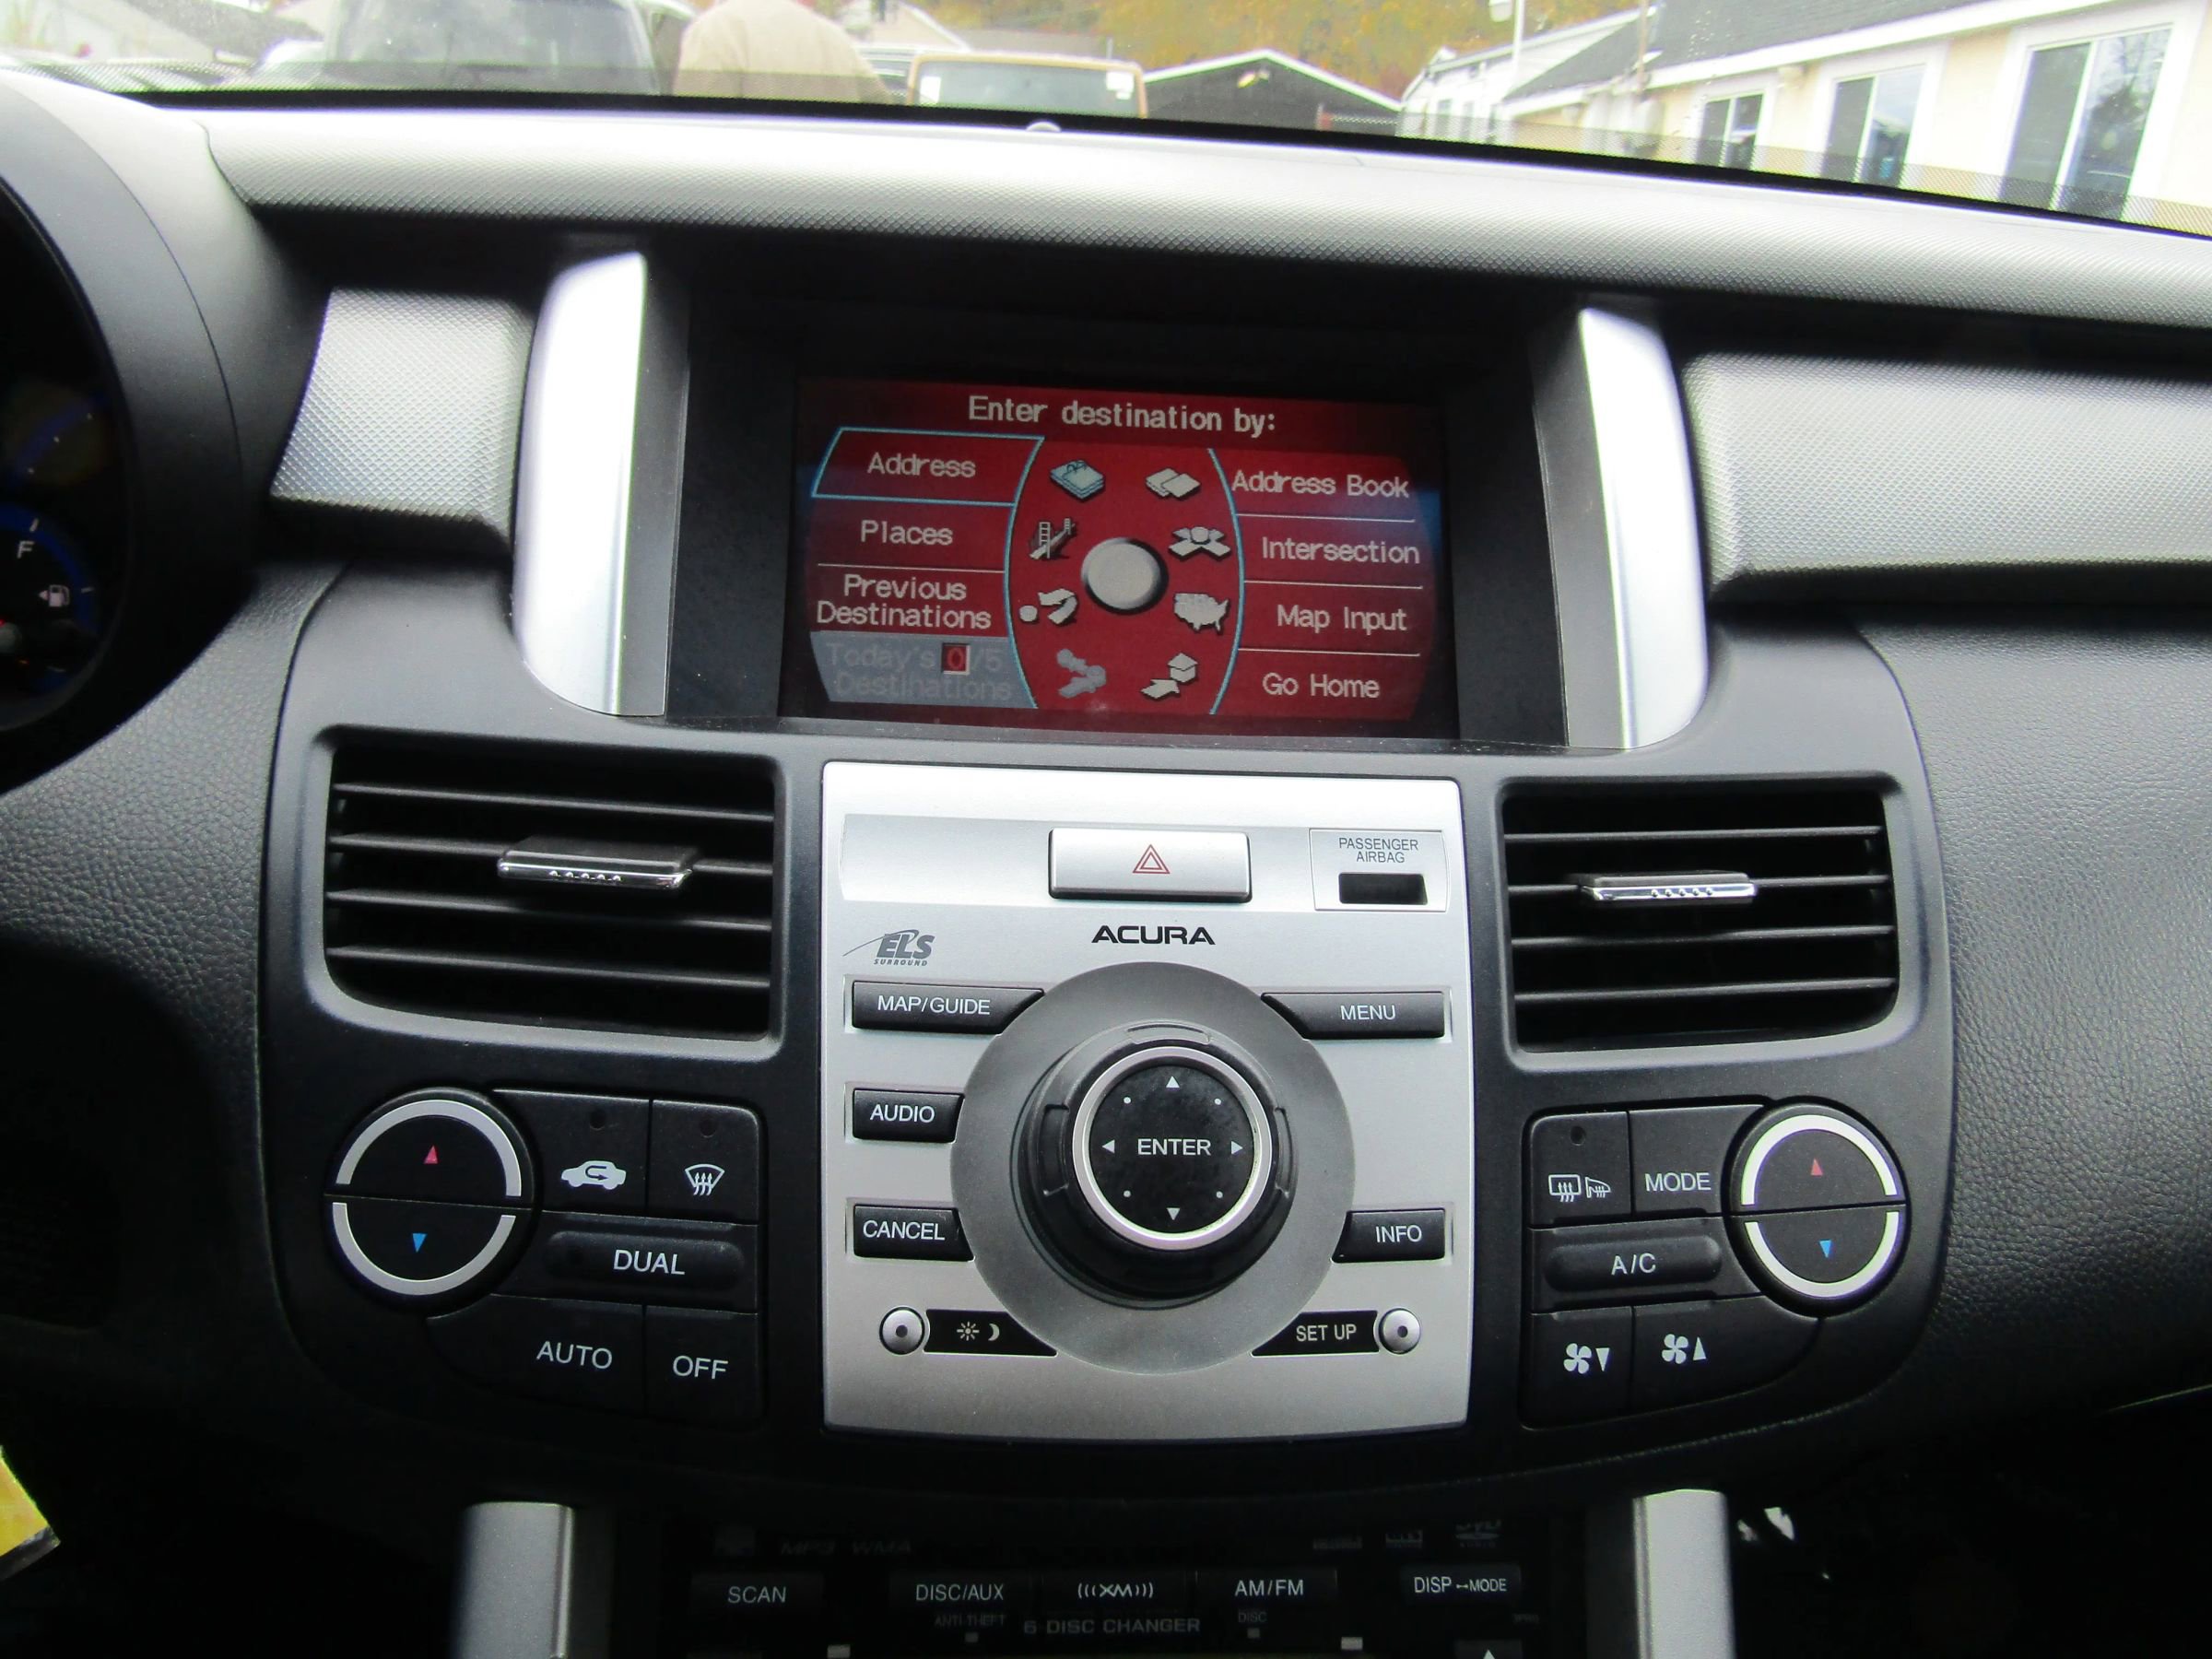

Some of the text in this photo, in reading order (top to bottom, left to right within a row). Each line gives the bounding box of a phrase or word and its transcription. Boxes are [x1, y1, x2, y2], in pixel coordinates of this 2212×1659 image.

[969, 395, 1276, 439] Enter destination by:
[867, 452, 976, 478] Address
[1231, 470, 1410, 499] Address Book
[861, 520, 954, 546] Places
[17, 540, 34, 559] F
[1262, 536, 1420, 565] Intersection
[843, 573, 967, 601] Previous
[816, 600, 992, 630] Destinations
[1277, 605, 1407, 635] Map Input
[835, 670, 1014, 701] Destinations
[1262, 672, 1381, 699] Go Home
[1338, 837, 1419, 852] PASSENGER
[1356, 851, 1406, 865] AIRBAG
[1091, 924, 1216, 946] ACURA
[873, 958, 929, 968] SURROUND
[877, 994, 991, 1016] MAP/GUIDE
[1340, 1004, 1396, 1021] MENU
[869, 1103, 935, 1124] AUDIO
[1136, 1137, 1212, 1157] ENTER
[1644, 1171, 1712, 1193] MODE
[862, 1219, 946, 1241] CANCEL
[1375, 1225, 1422, 1244] INFO
[613, 1249, 685, 1275] DUAL
[1610, 1252, 1657, 1277] A/C
[1295, 1323, 1358, 1343] SET UP
[536, 1340, 613, 1370] AUTO
[672, 1355, 728, 1379] OFF
[727, 1585, 787, 1605] SCAN
[915, 1583, 1005, 1602] DISC/AUX
[1234, 1579, 1305, 1597] AM/FM
[1413, 1576, 1507, 1594] DISP MODE
[1023, 1618, 1201, 1635] 6 DISC CHANGER
[1238, 1610, 1267, 1623] DISC
